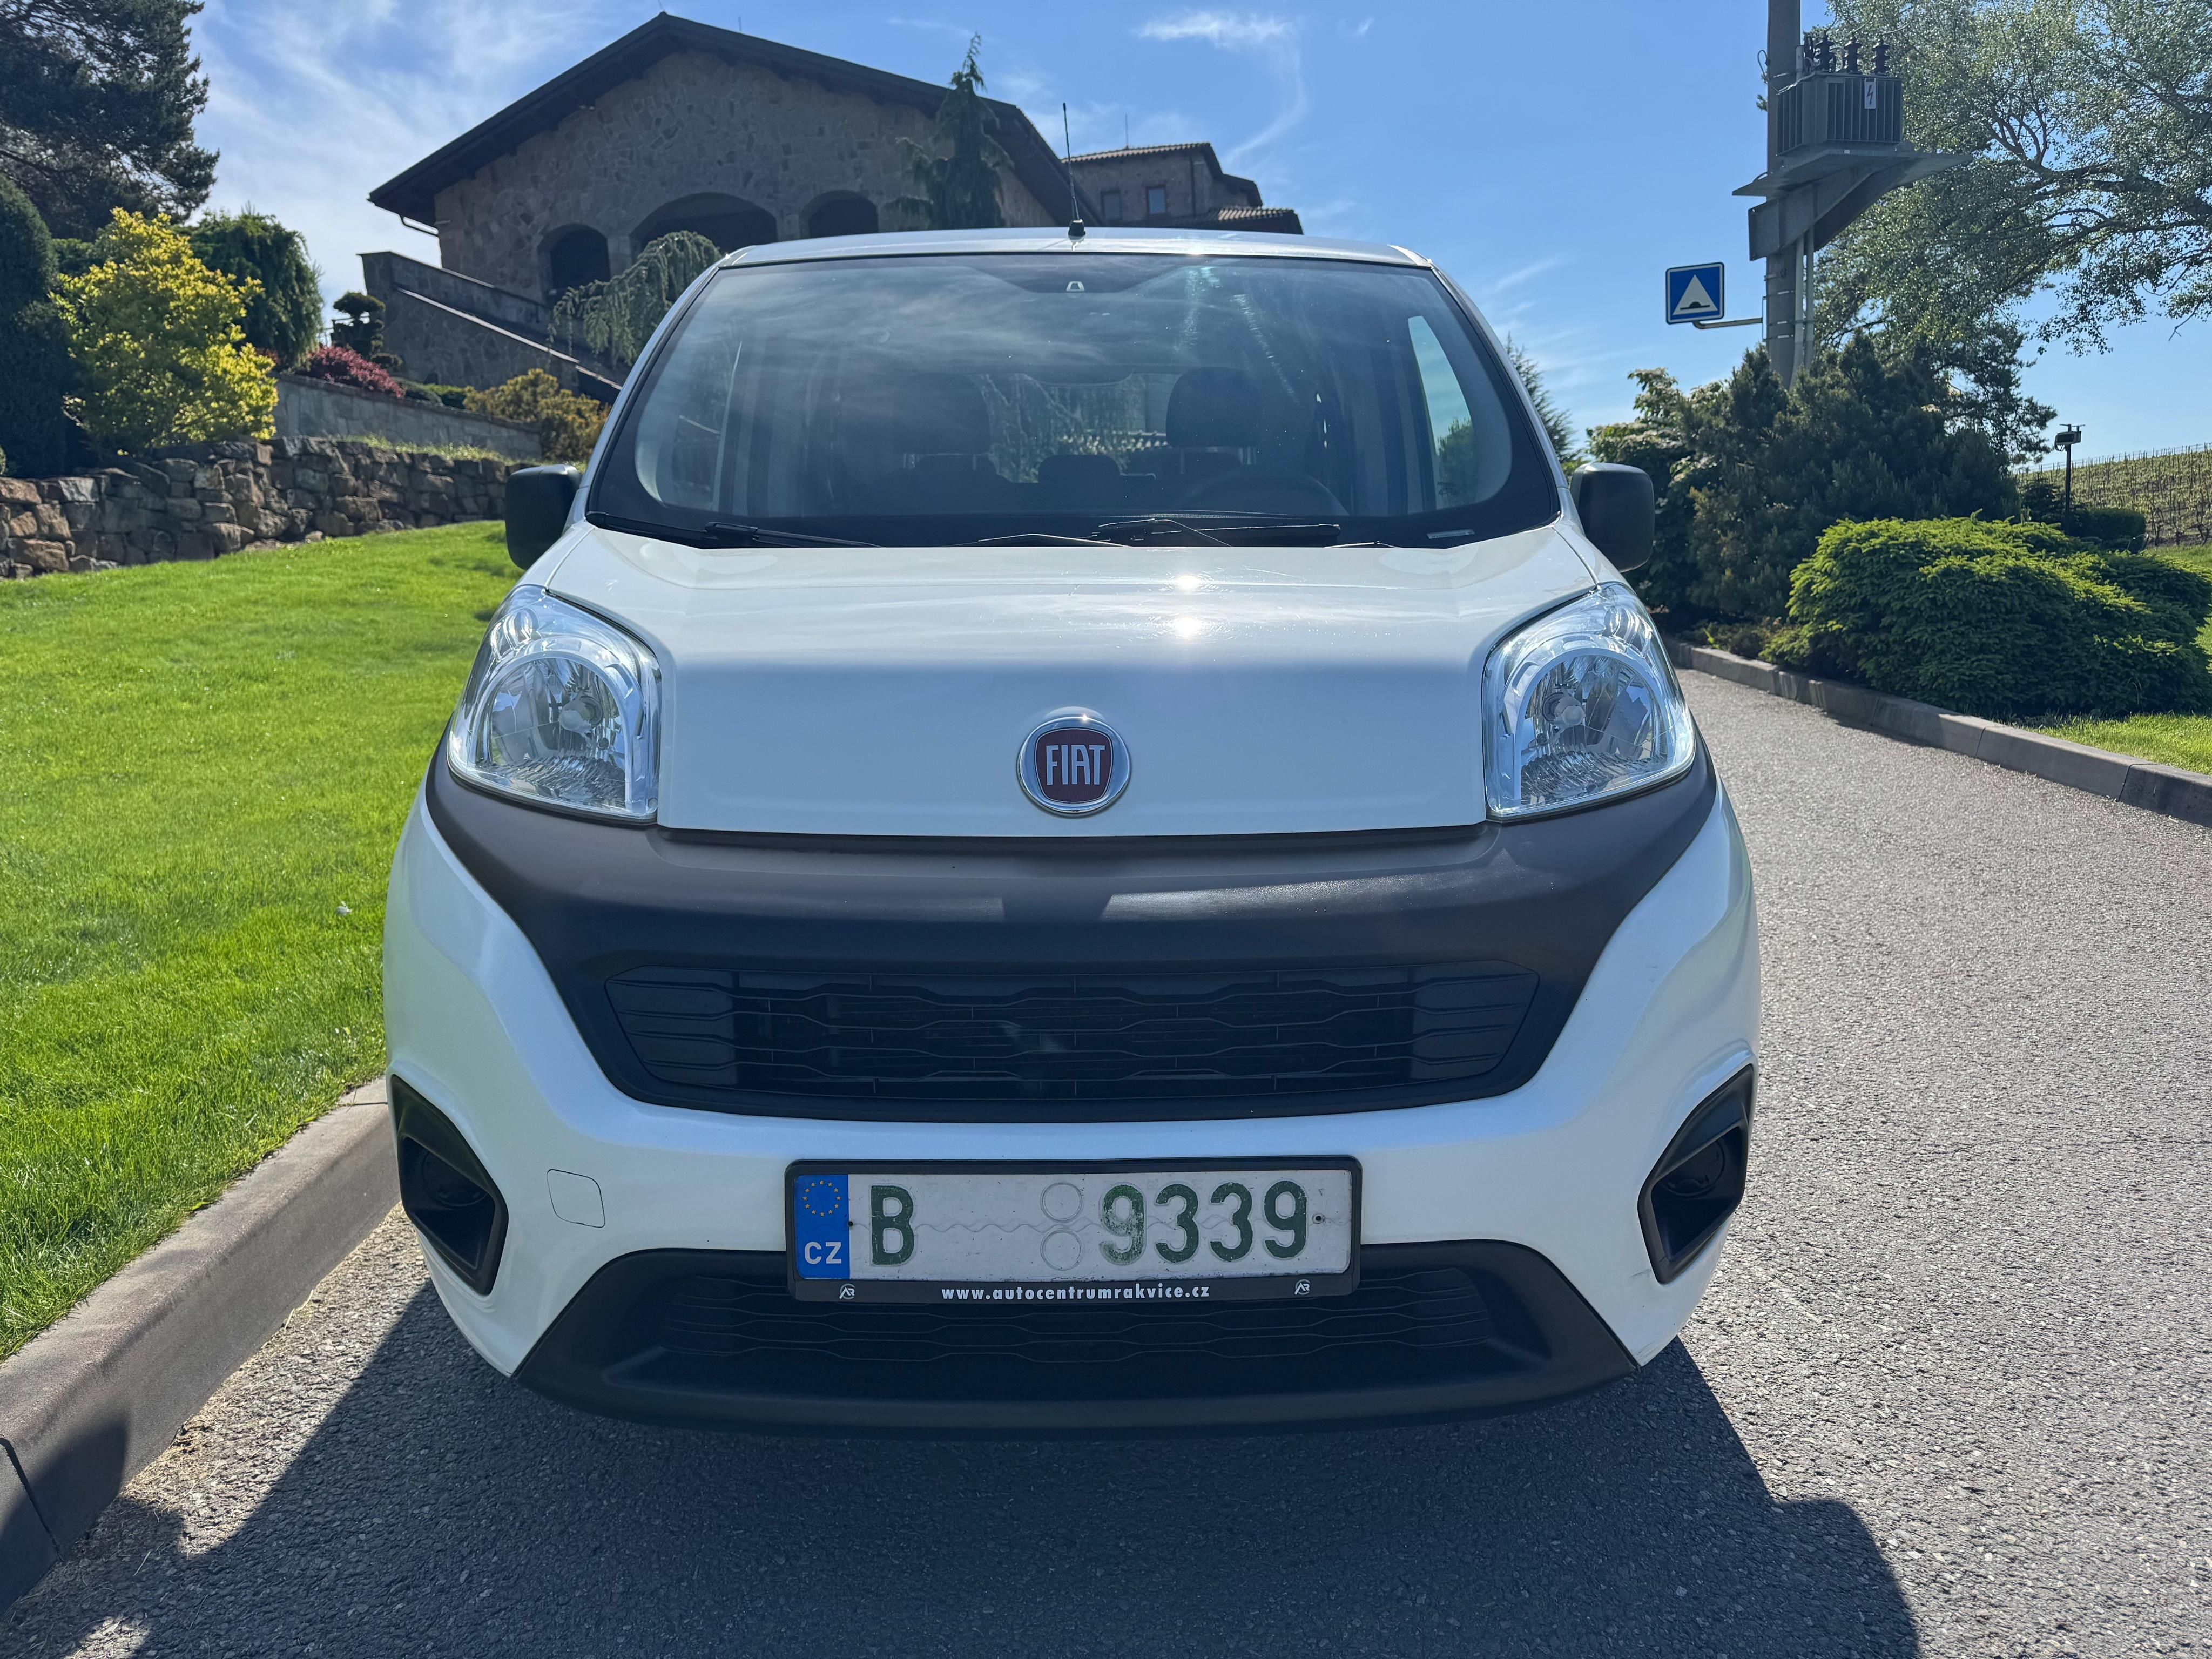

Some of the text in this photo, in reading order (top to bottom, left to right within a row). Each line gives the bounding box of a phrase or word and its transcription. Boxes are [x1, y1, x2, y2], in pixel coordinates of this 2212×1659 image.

[1046, 744, 1106, 785] FIAT
[871, 1180, 1308, 1265] B 9339
[804, 1242, 842, 1265] CZ
[941, 1283, 1210, 1300] www.autocentrumrakvice.cz
